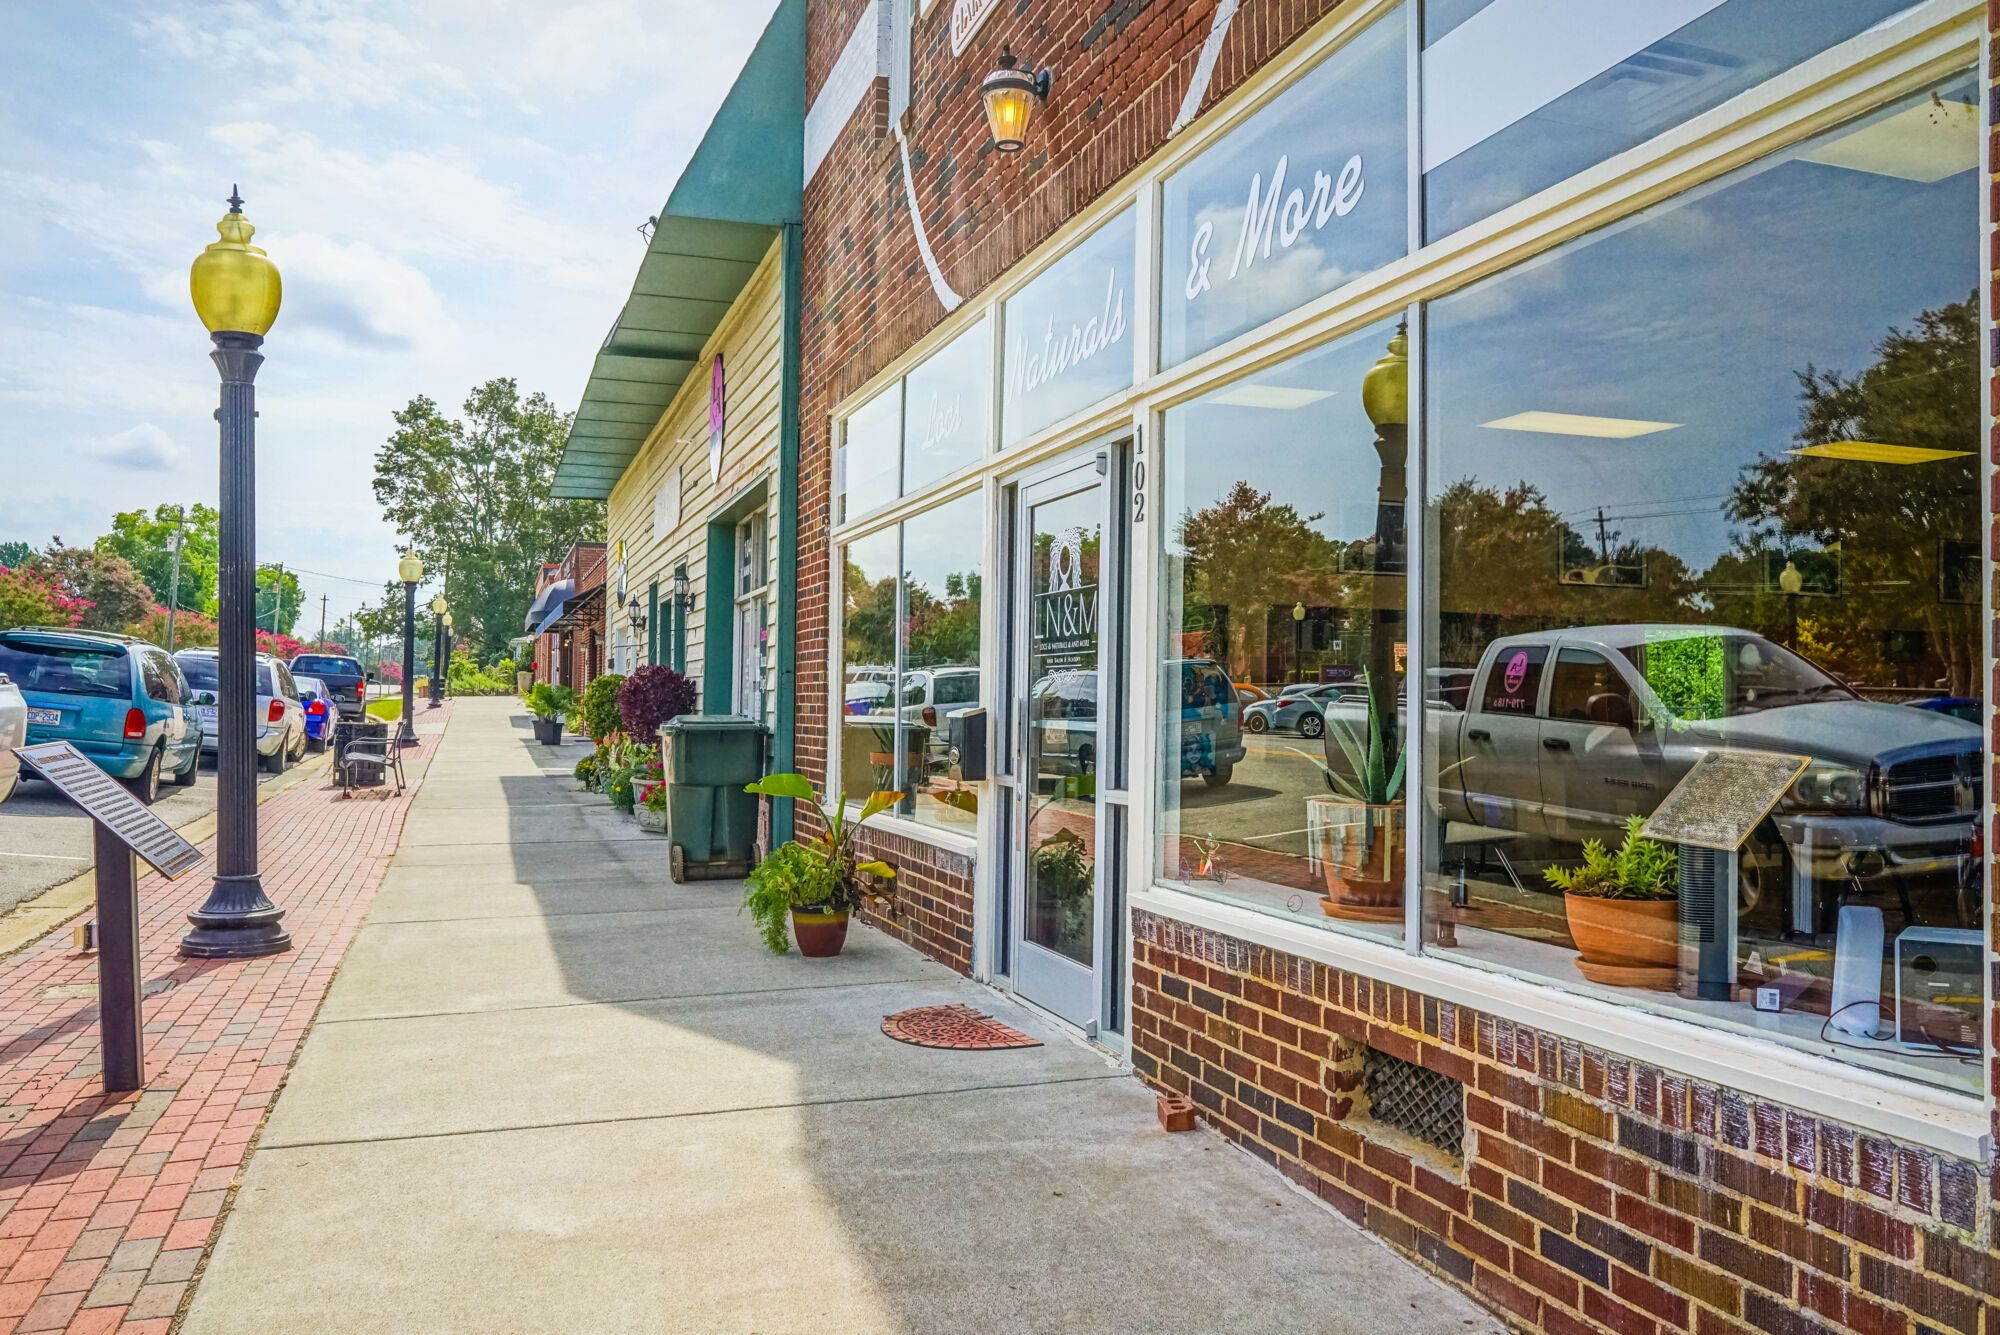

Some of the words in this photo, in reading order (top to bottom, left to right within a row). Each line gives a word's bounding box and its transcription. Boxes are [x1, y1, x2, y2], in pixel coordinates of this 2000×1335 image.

[922, 391, 962, 450] Locs
[1009, 267, 1127, 405] Naturals
[1185, 220, 1213, 300] &
[1228, 154, 1365, 281] More
[1134, 424, 1145, 522] 102
[1034, 591, 1097, 639] LN&M
